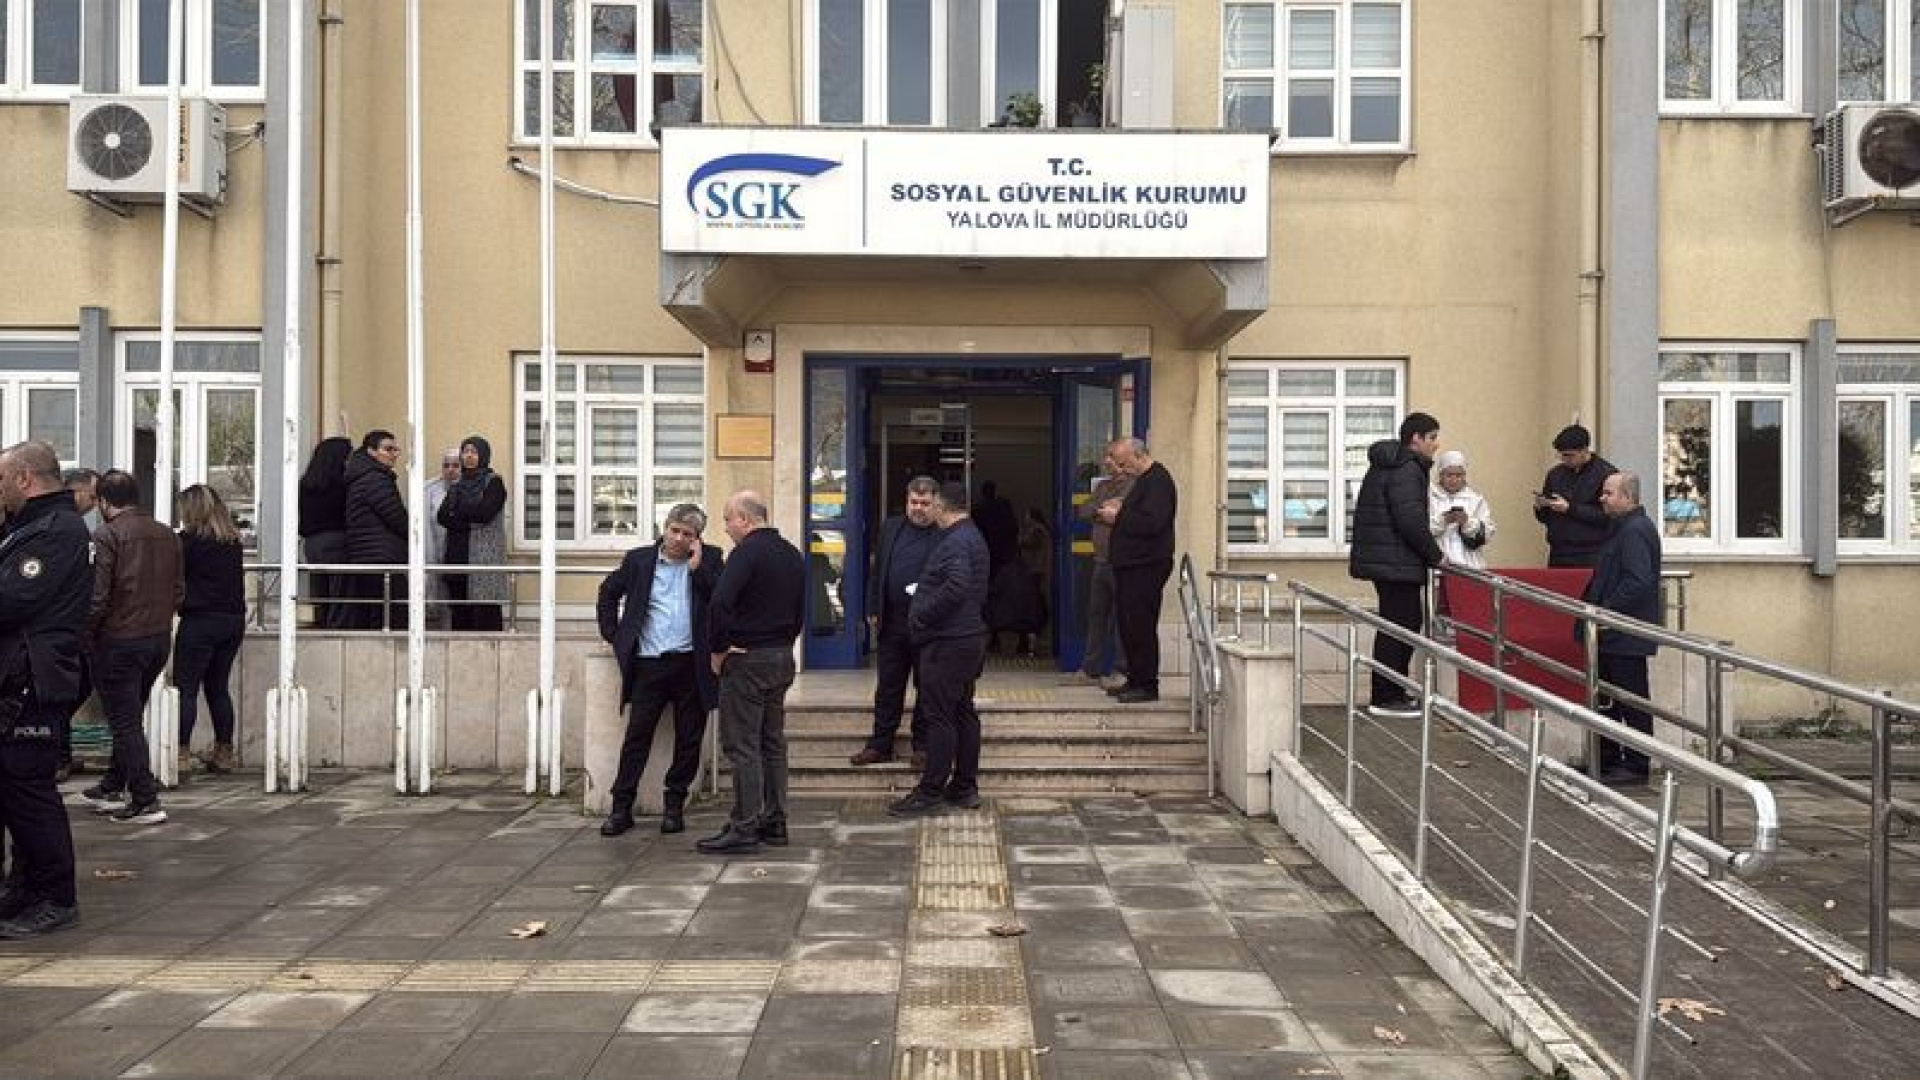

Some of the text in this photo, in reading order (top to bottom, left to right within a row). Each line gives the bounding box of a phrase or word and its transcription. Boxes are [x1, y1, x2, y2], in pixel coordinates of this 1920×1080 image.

[1047, 158, 1092, 176] T.C.
[705, 182, 806, 220] SGK
[890, 182, 1246, 205] SOSYAL GÜVENLİK KURUMU
[946, 208, 1188, 230] YALOVA İL MÜDÜRLÜĞÜ
